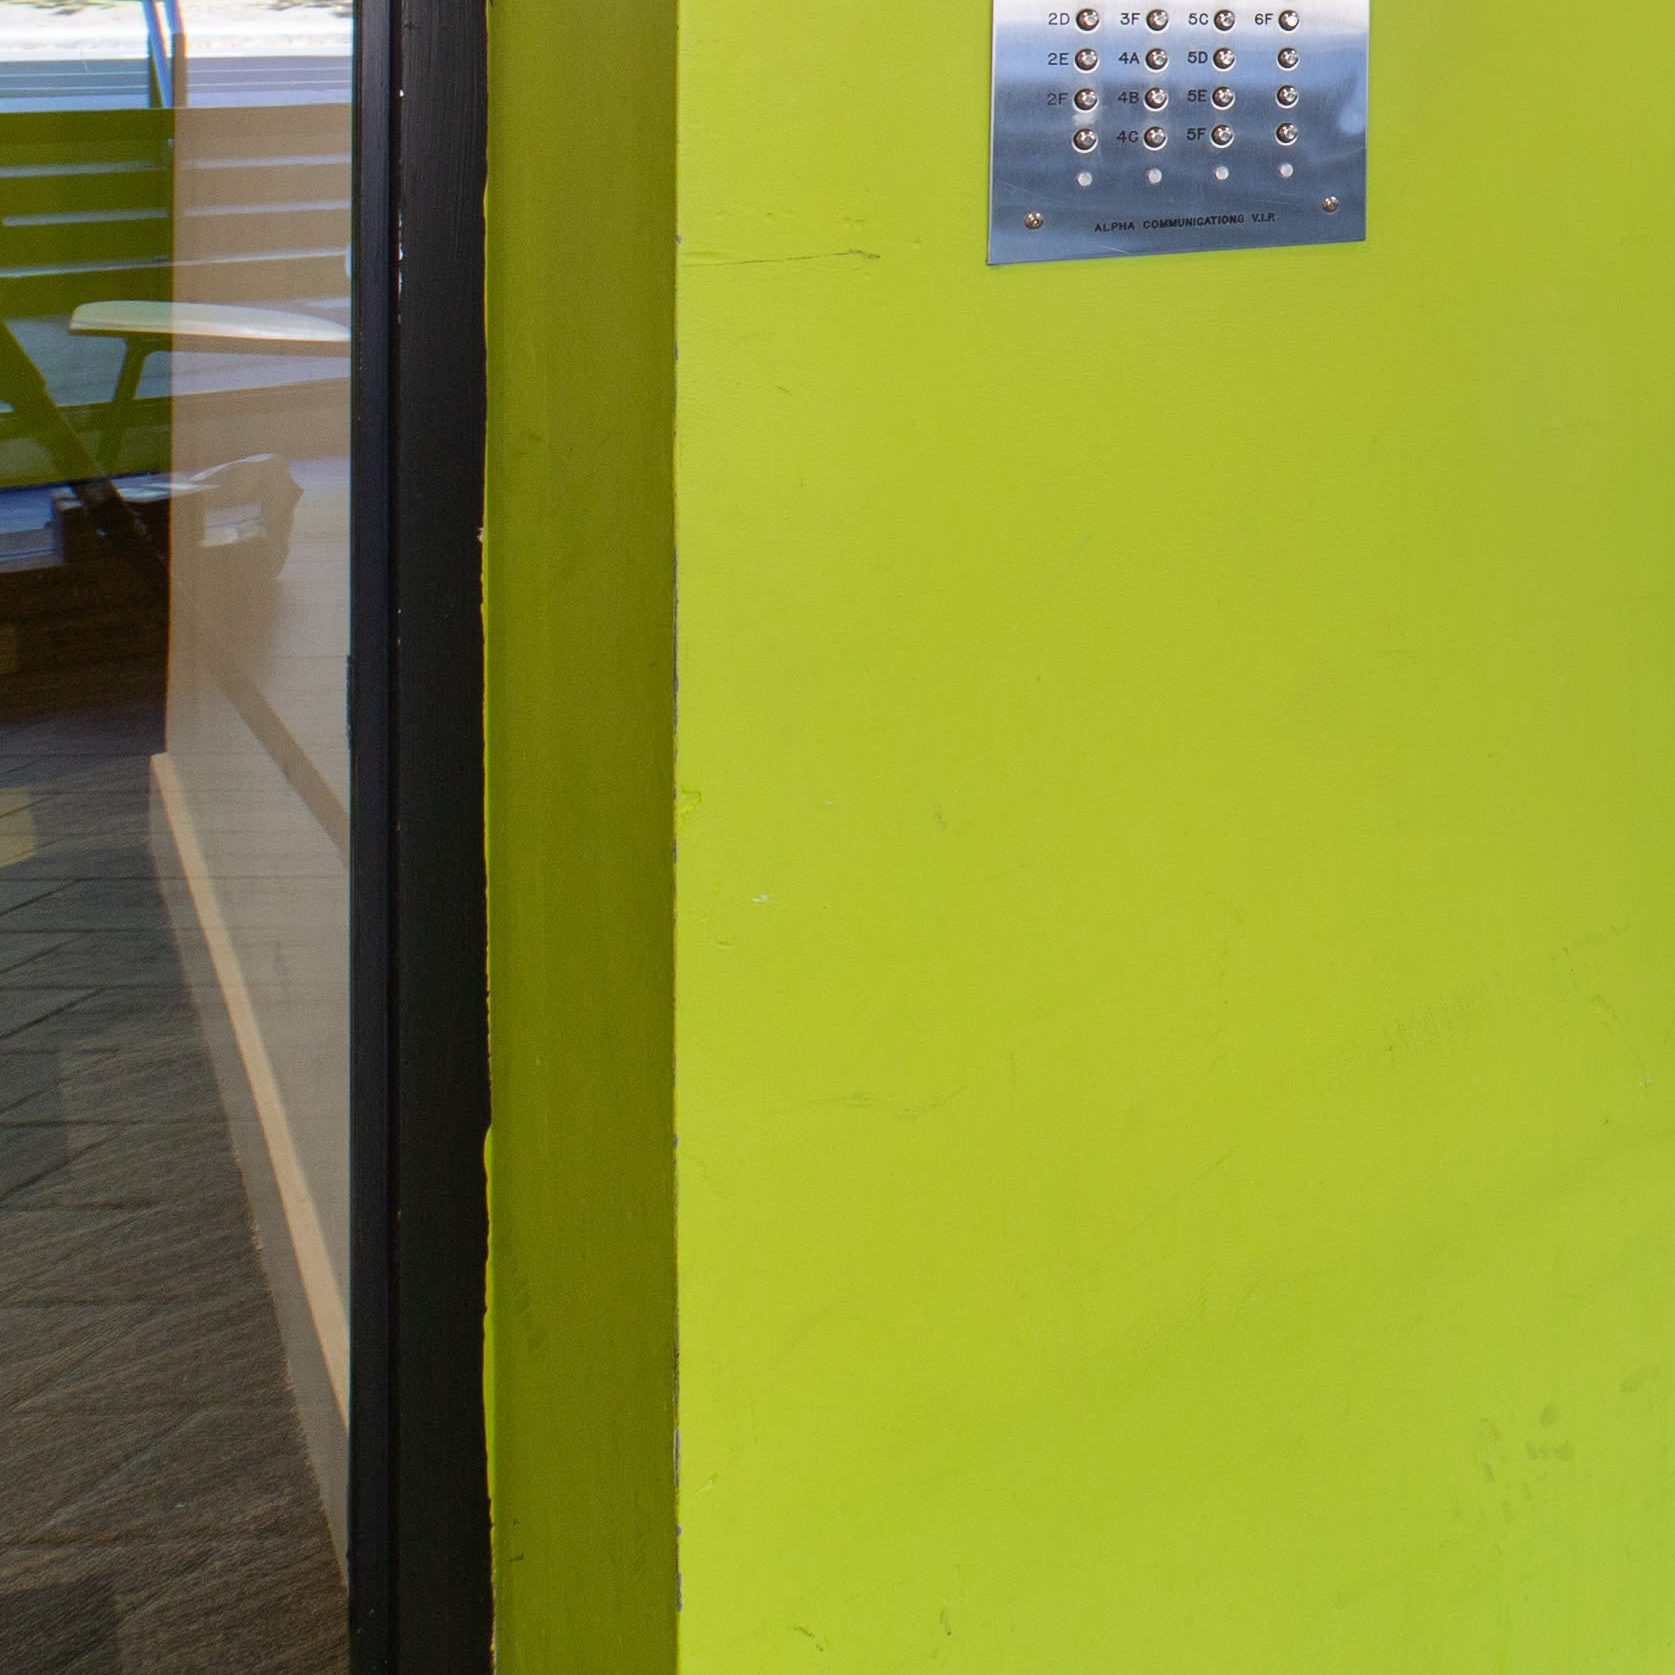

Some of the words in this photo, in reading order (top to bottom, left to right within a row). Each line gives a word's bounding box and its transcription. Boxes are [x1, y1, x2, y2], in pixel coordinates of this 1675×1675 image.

[1047, 13, 1070, 26] 2D
[1119, 13, 1141, 25] 3F
[1188, 13, 1209, 26] 5C
[1254, 13, 1273, 26] 6F
[1047, 53, 1069, 66] 2E
[1118, 52, 1140, 65] 4A
[1187, 51, 1208, 64] 5D
[1046, 93, 1069, 106] 2F
[1117, 91, 1140, 104] 4B
[1187, 89, 1207, 103] 5E
[1116, 130, 1139, 144] 4C
[1186, 128, 1206, 141] 5F
[1094, 221, 1135, 233] ALPHA
[1143, 214, 1245, 230] COMMUNICATIONS
